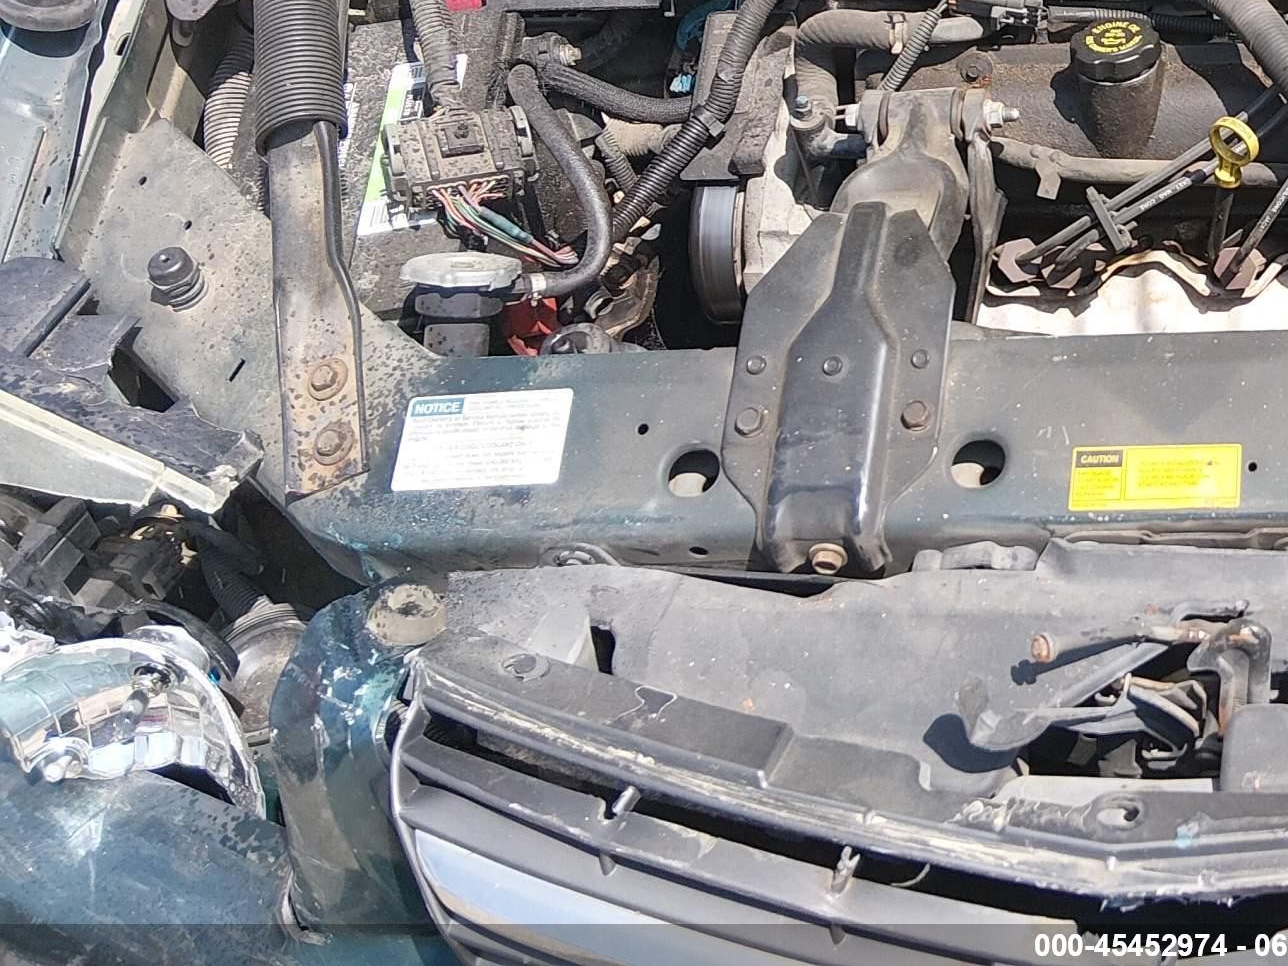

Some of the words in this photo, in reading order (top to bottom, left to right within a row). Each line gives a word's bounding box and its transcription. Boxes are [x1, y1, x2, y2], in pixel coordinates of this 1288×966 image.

[1091, 21, 1129, 34] ENGINE
[414, 401, 461, 415] NOTICE
[1080, 454, 1120, 464] CAUTION
